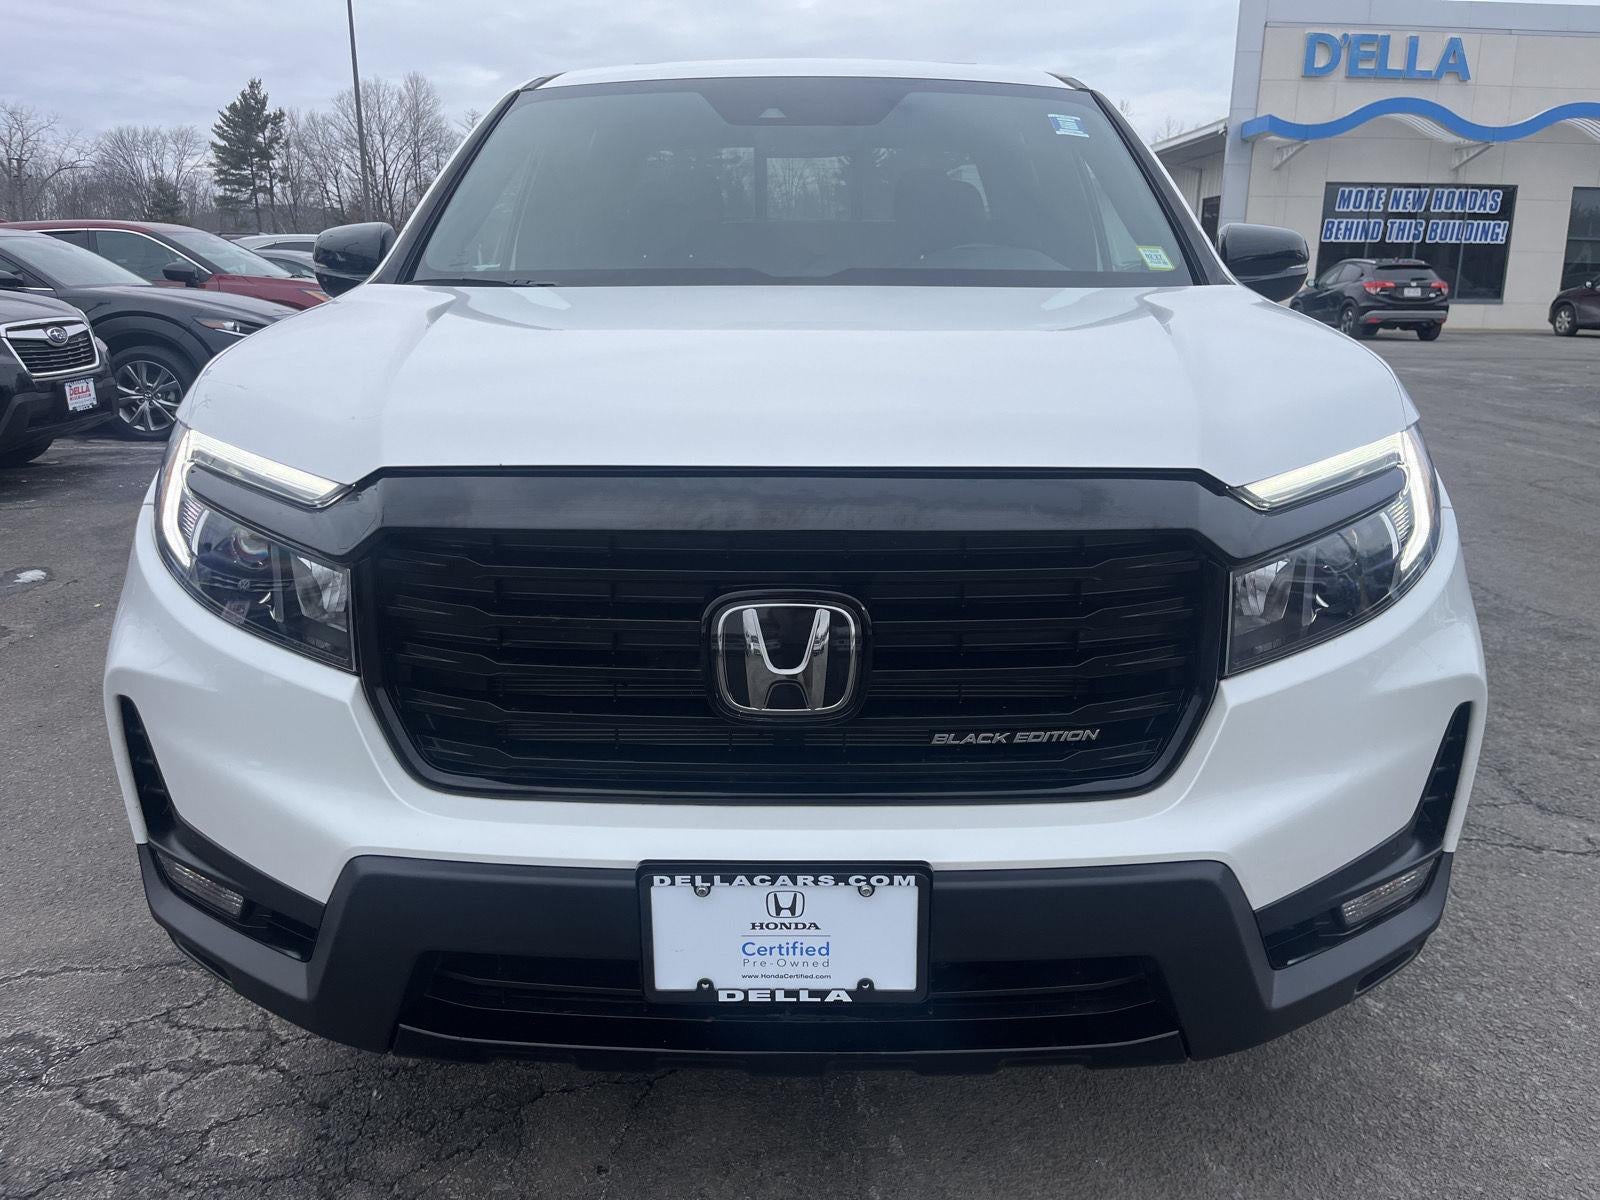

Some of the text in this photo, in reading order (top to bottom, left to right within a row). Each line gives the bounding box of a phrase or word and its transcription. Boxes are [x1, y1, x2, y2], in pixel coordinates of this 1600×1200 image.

[1303, 32, 1471, 81] D'ELLA
[1335, 187, 1503, 214] MORE NEW HONDAS
[1321, 219, 1509, 244] BEHIND THIS BUILDING!
[69, 385, 91, 396] DELLA
[931, 728, 1100, 745] BLACK EDITION
[652, 875, 917, 887] DELLACARS.COM
[750, 922, 821, 930] HONDA
[741, 941, 830, 957] Certified
[743, 958, 830, 968] Pre-Owned
[718, 989, 853, 1002] DELLA
